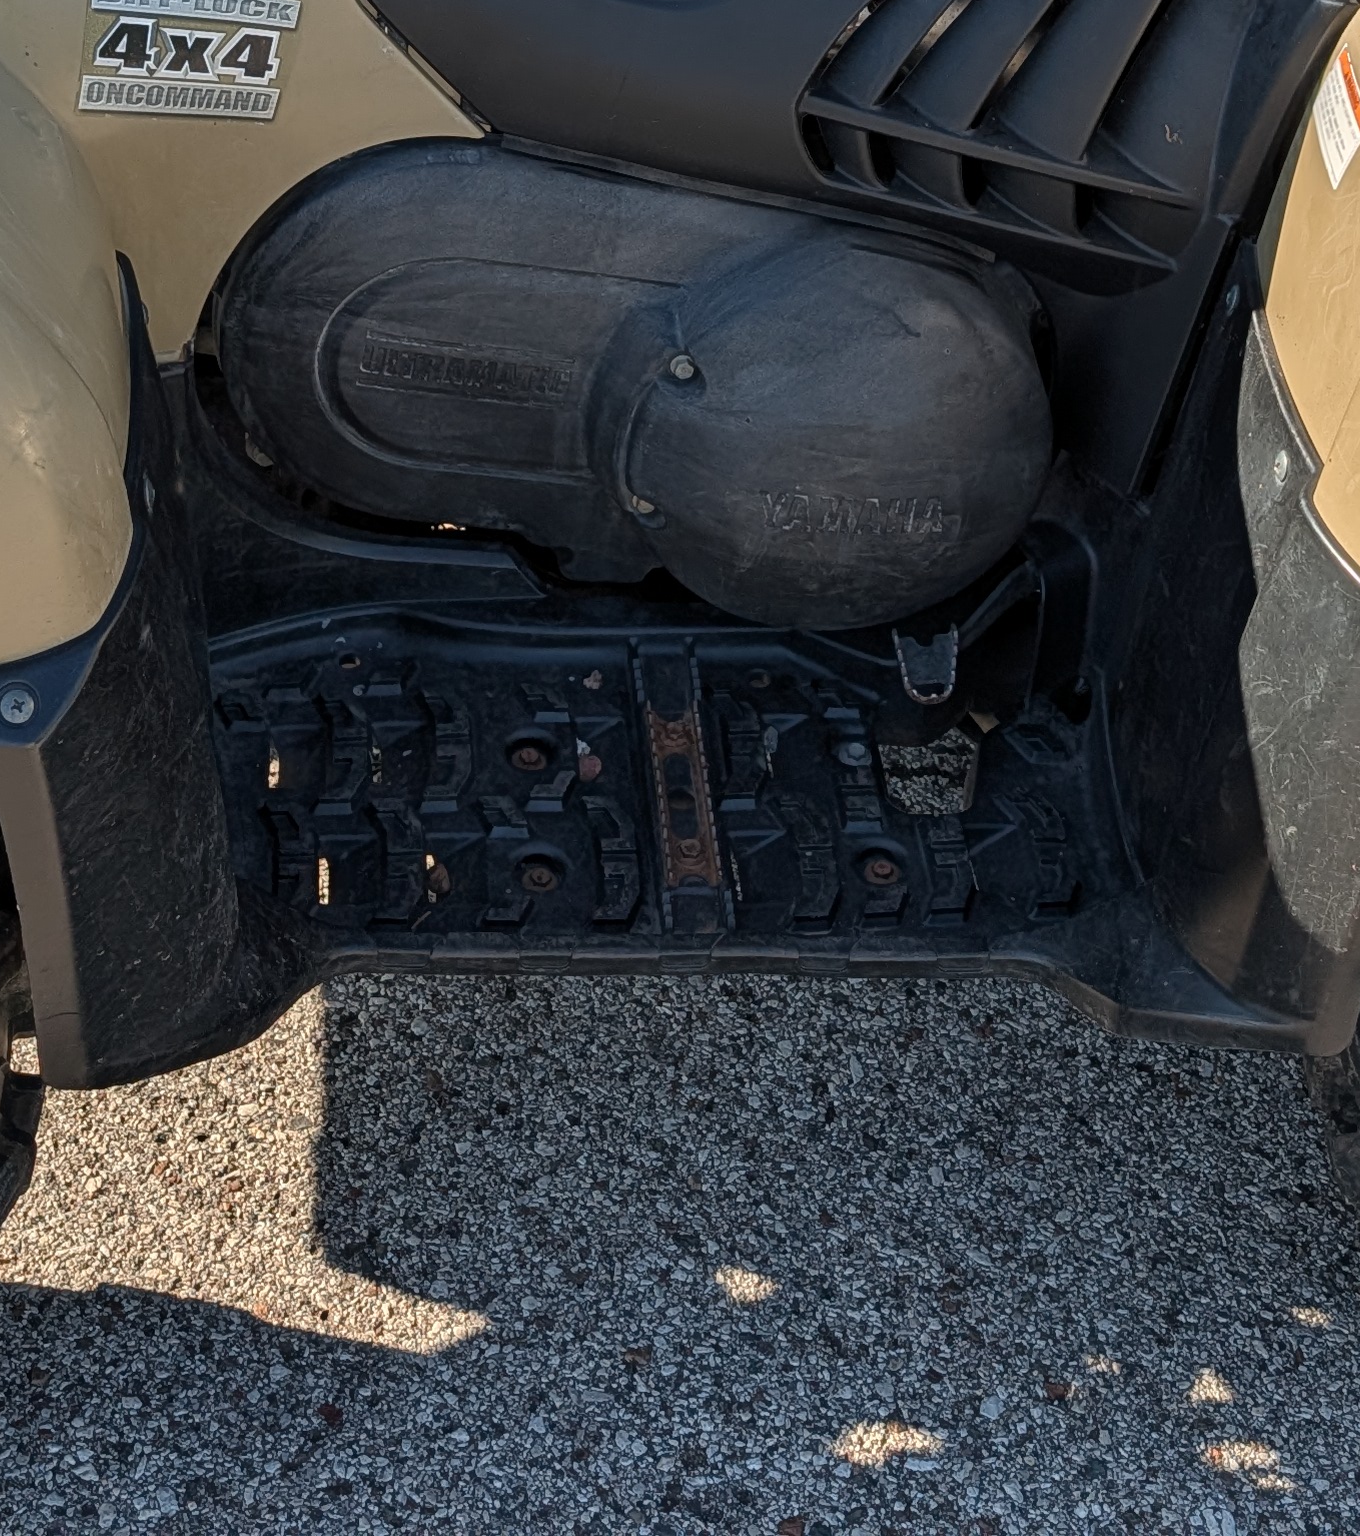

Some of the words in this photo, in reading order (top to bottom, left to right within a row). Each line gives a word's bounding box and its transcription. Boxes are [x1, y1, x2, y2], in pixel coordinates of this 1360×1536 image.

[93, 16, 281, 85] 4x4
[86, 80, 273, 112] ONCOMMAND
[359, 344, 573, 397] ULTRAMATIC
[758, 489, 943, 536] YAMAHA
